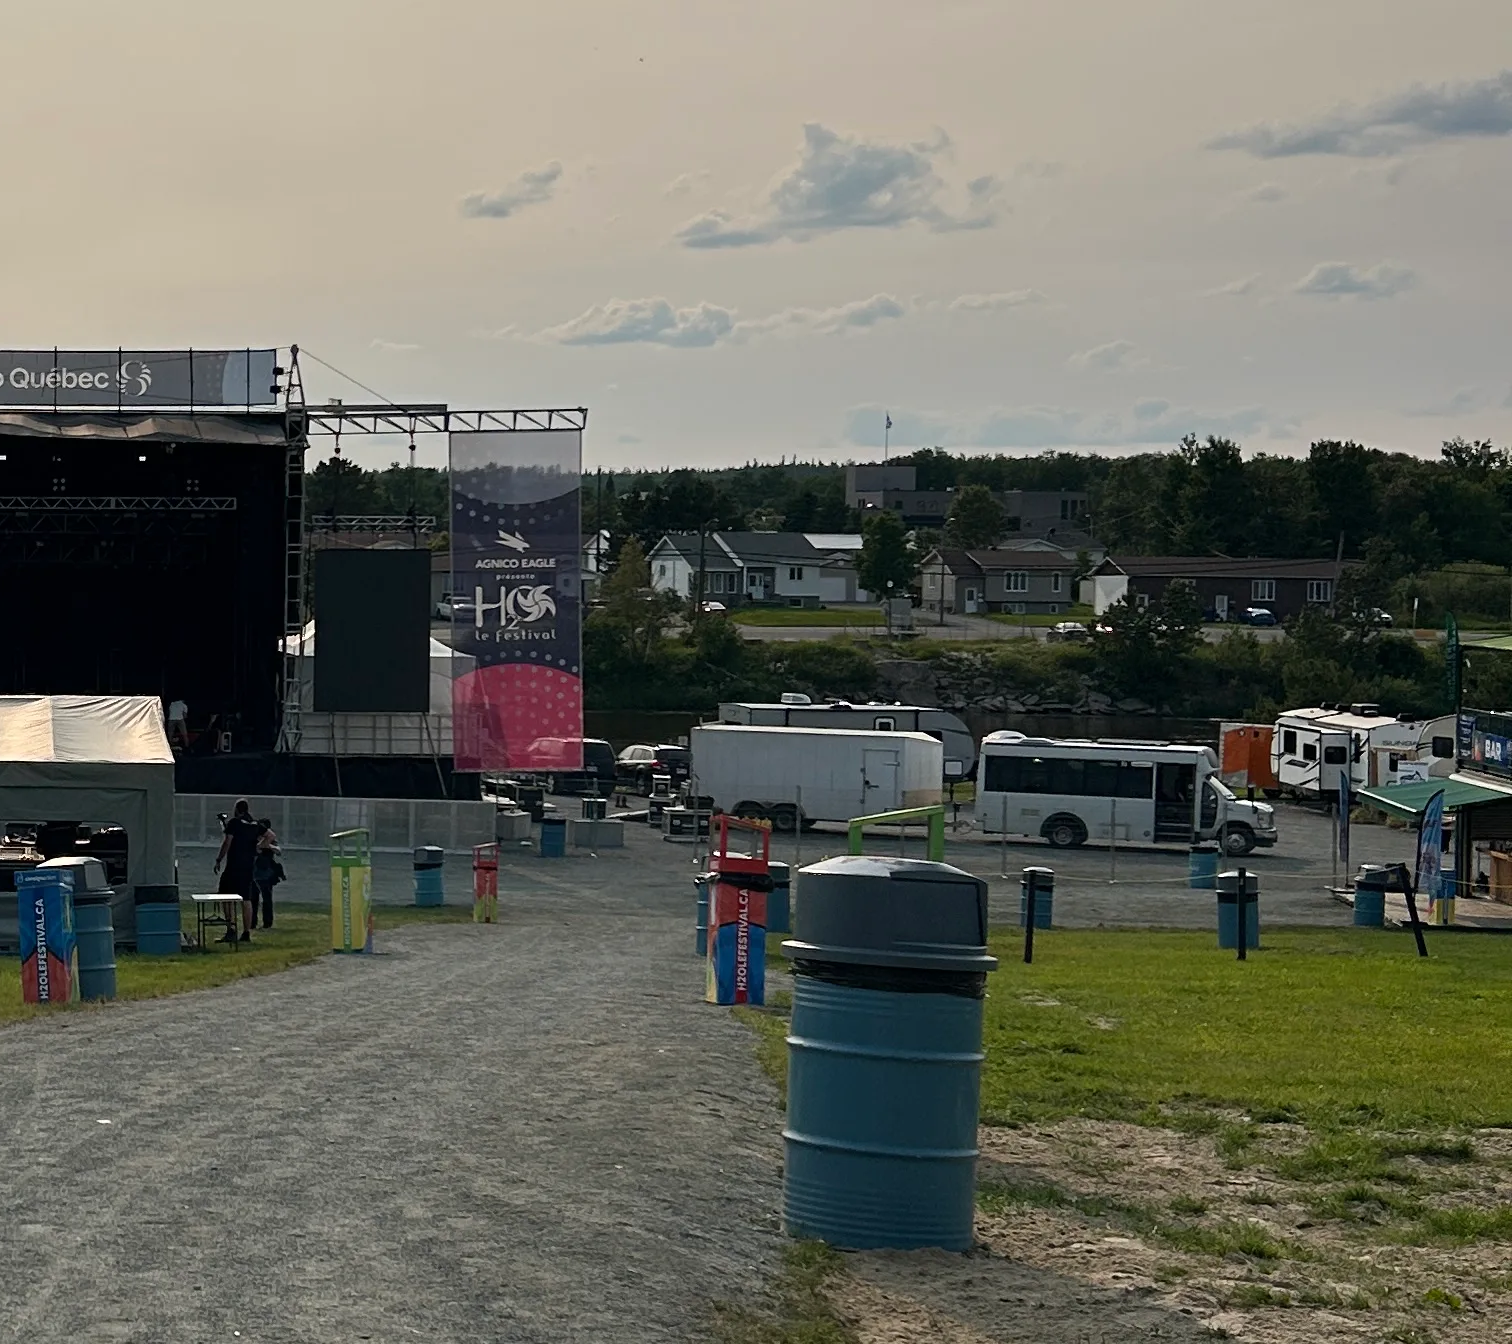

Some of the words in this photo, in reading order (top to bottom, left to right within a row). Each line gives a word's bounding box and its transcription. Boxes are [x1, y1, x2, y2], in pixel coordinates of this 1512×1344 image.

[9, 367, 109, 390] Québec
[475, 559, 519, 569] AGNICO
[521, 558, 556, 568] EAGLE
[475, 630, 490, 641] le
[1485, 739, 1502, 761] BAR
